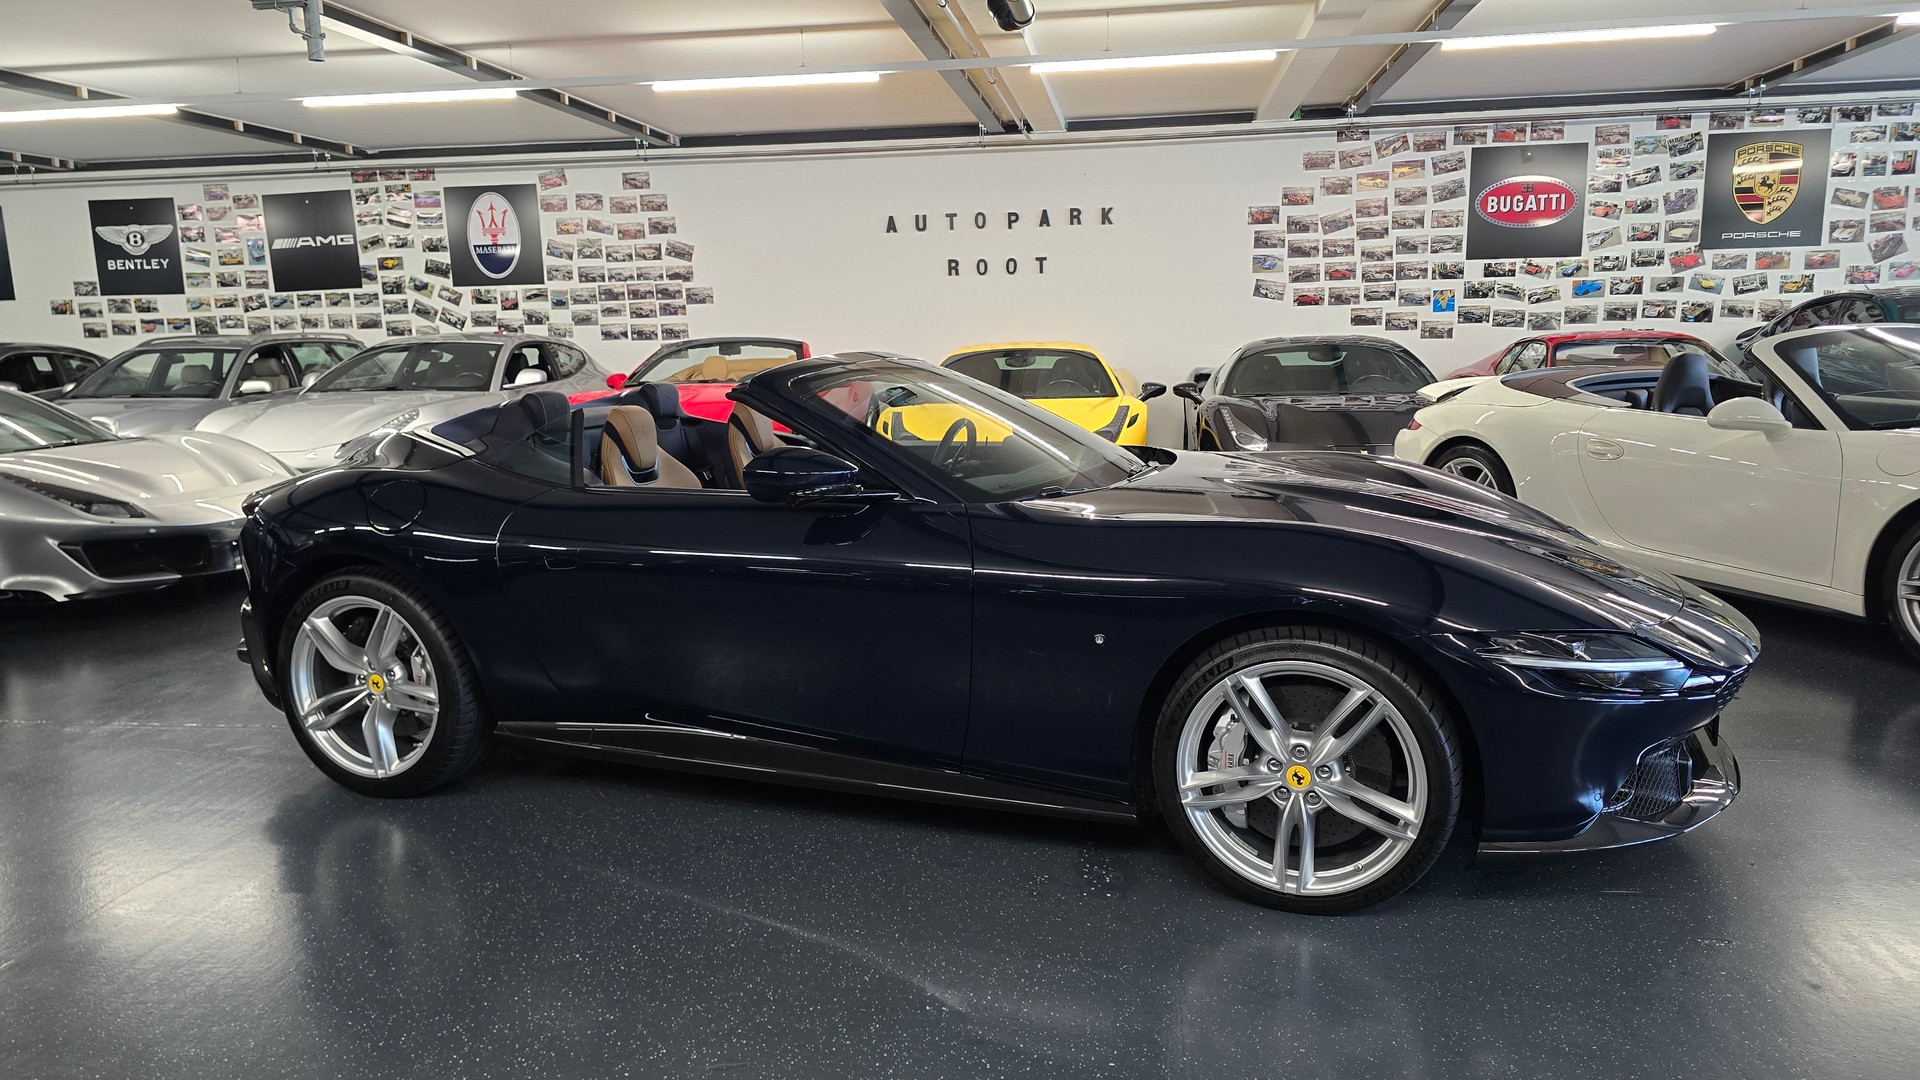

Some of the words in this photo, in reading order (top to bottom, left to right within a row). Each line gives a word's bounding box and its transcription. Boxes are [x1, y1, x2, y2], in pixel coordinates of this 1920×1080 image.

[1737, 144, 1800, 158] PORSCHE
[1487, 193, 1566, 213] BUGATTI
[296, 234, 355, 248] AMG
[1721, 230, 1802, 240] PORSCHE
[107, 258, 169, 270] BENTLEY
[947, 256, 1048, 276] ROOT
